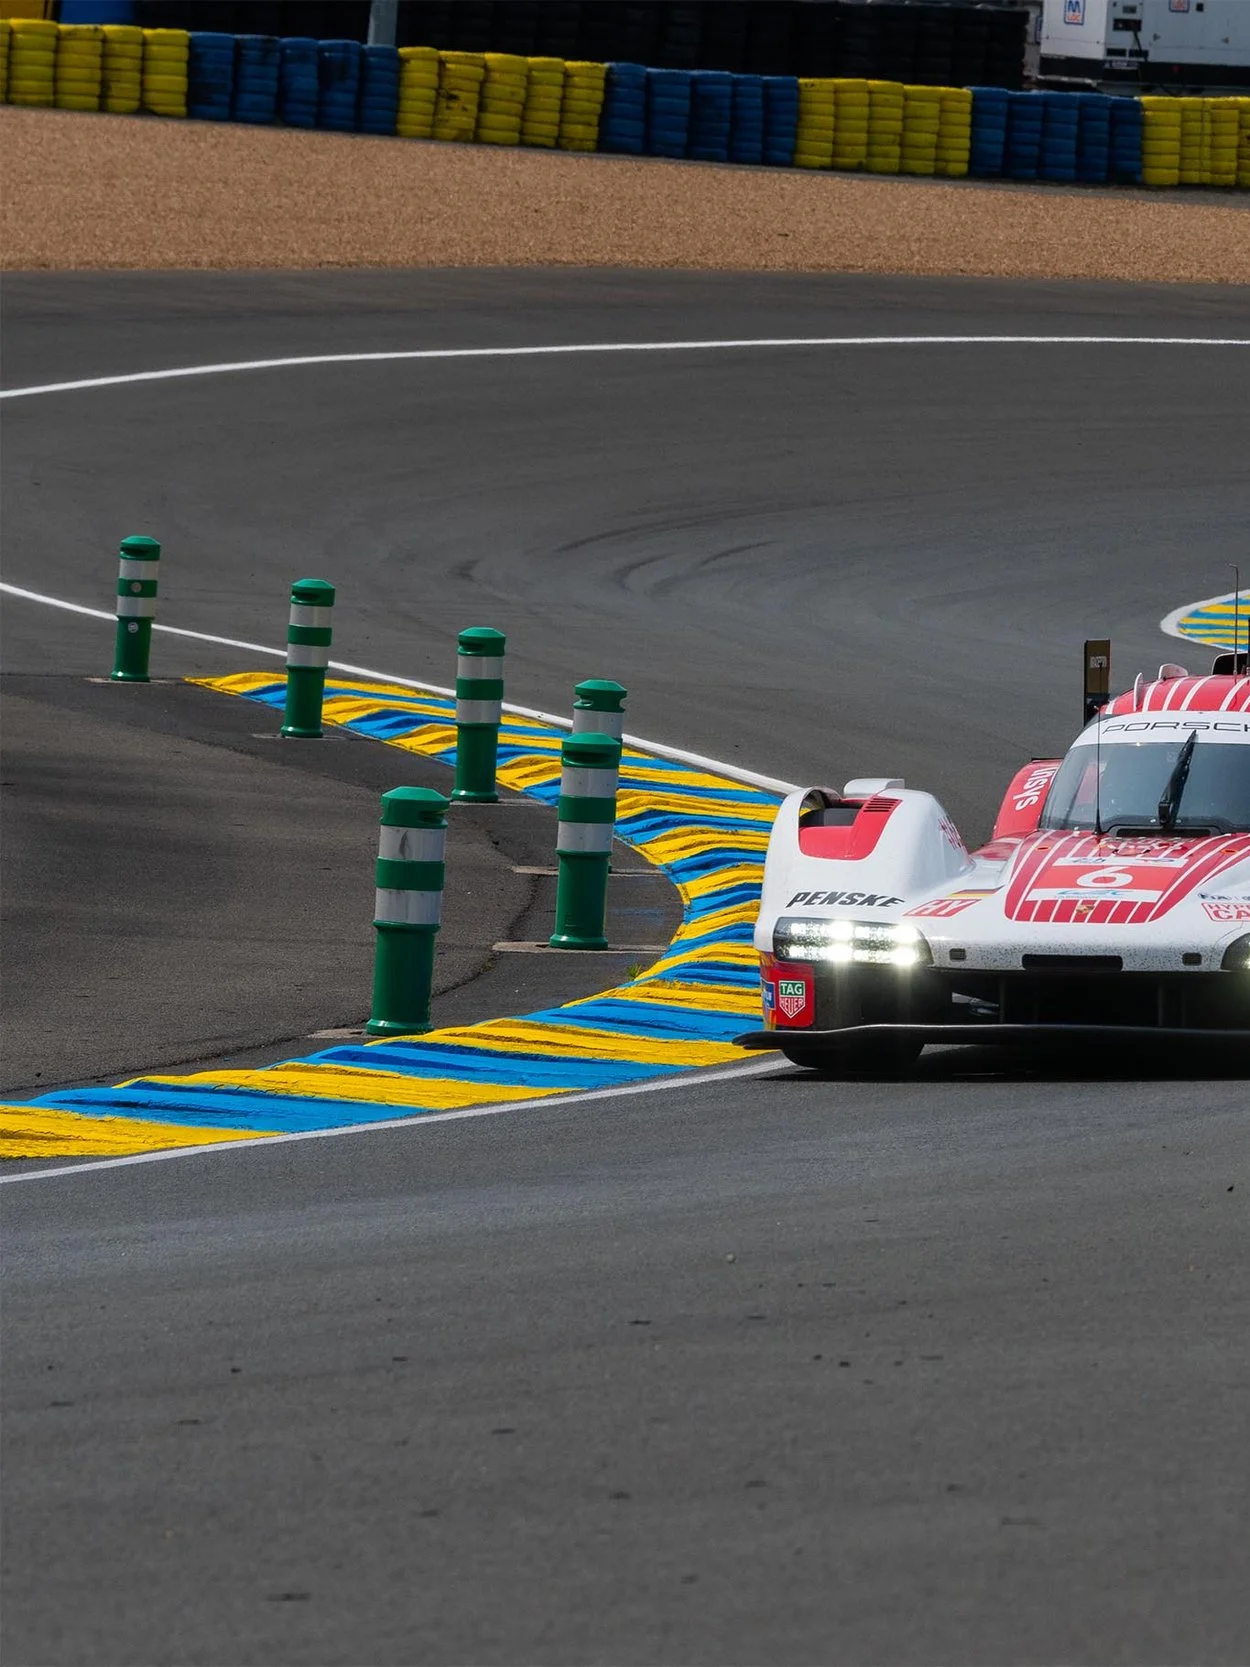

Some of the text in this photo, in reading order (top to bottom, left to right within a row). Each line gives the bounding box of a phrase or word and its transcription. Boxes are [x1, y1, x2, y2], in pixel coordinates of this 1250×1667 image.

[1076, 866, 1133, 888] 6
[786, 891, 905, 908] PENSKE
[780, 983, 803, 995] TAG
[780, 997, 805, 1015] HEUER
